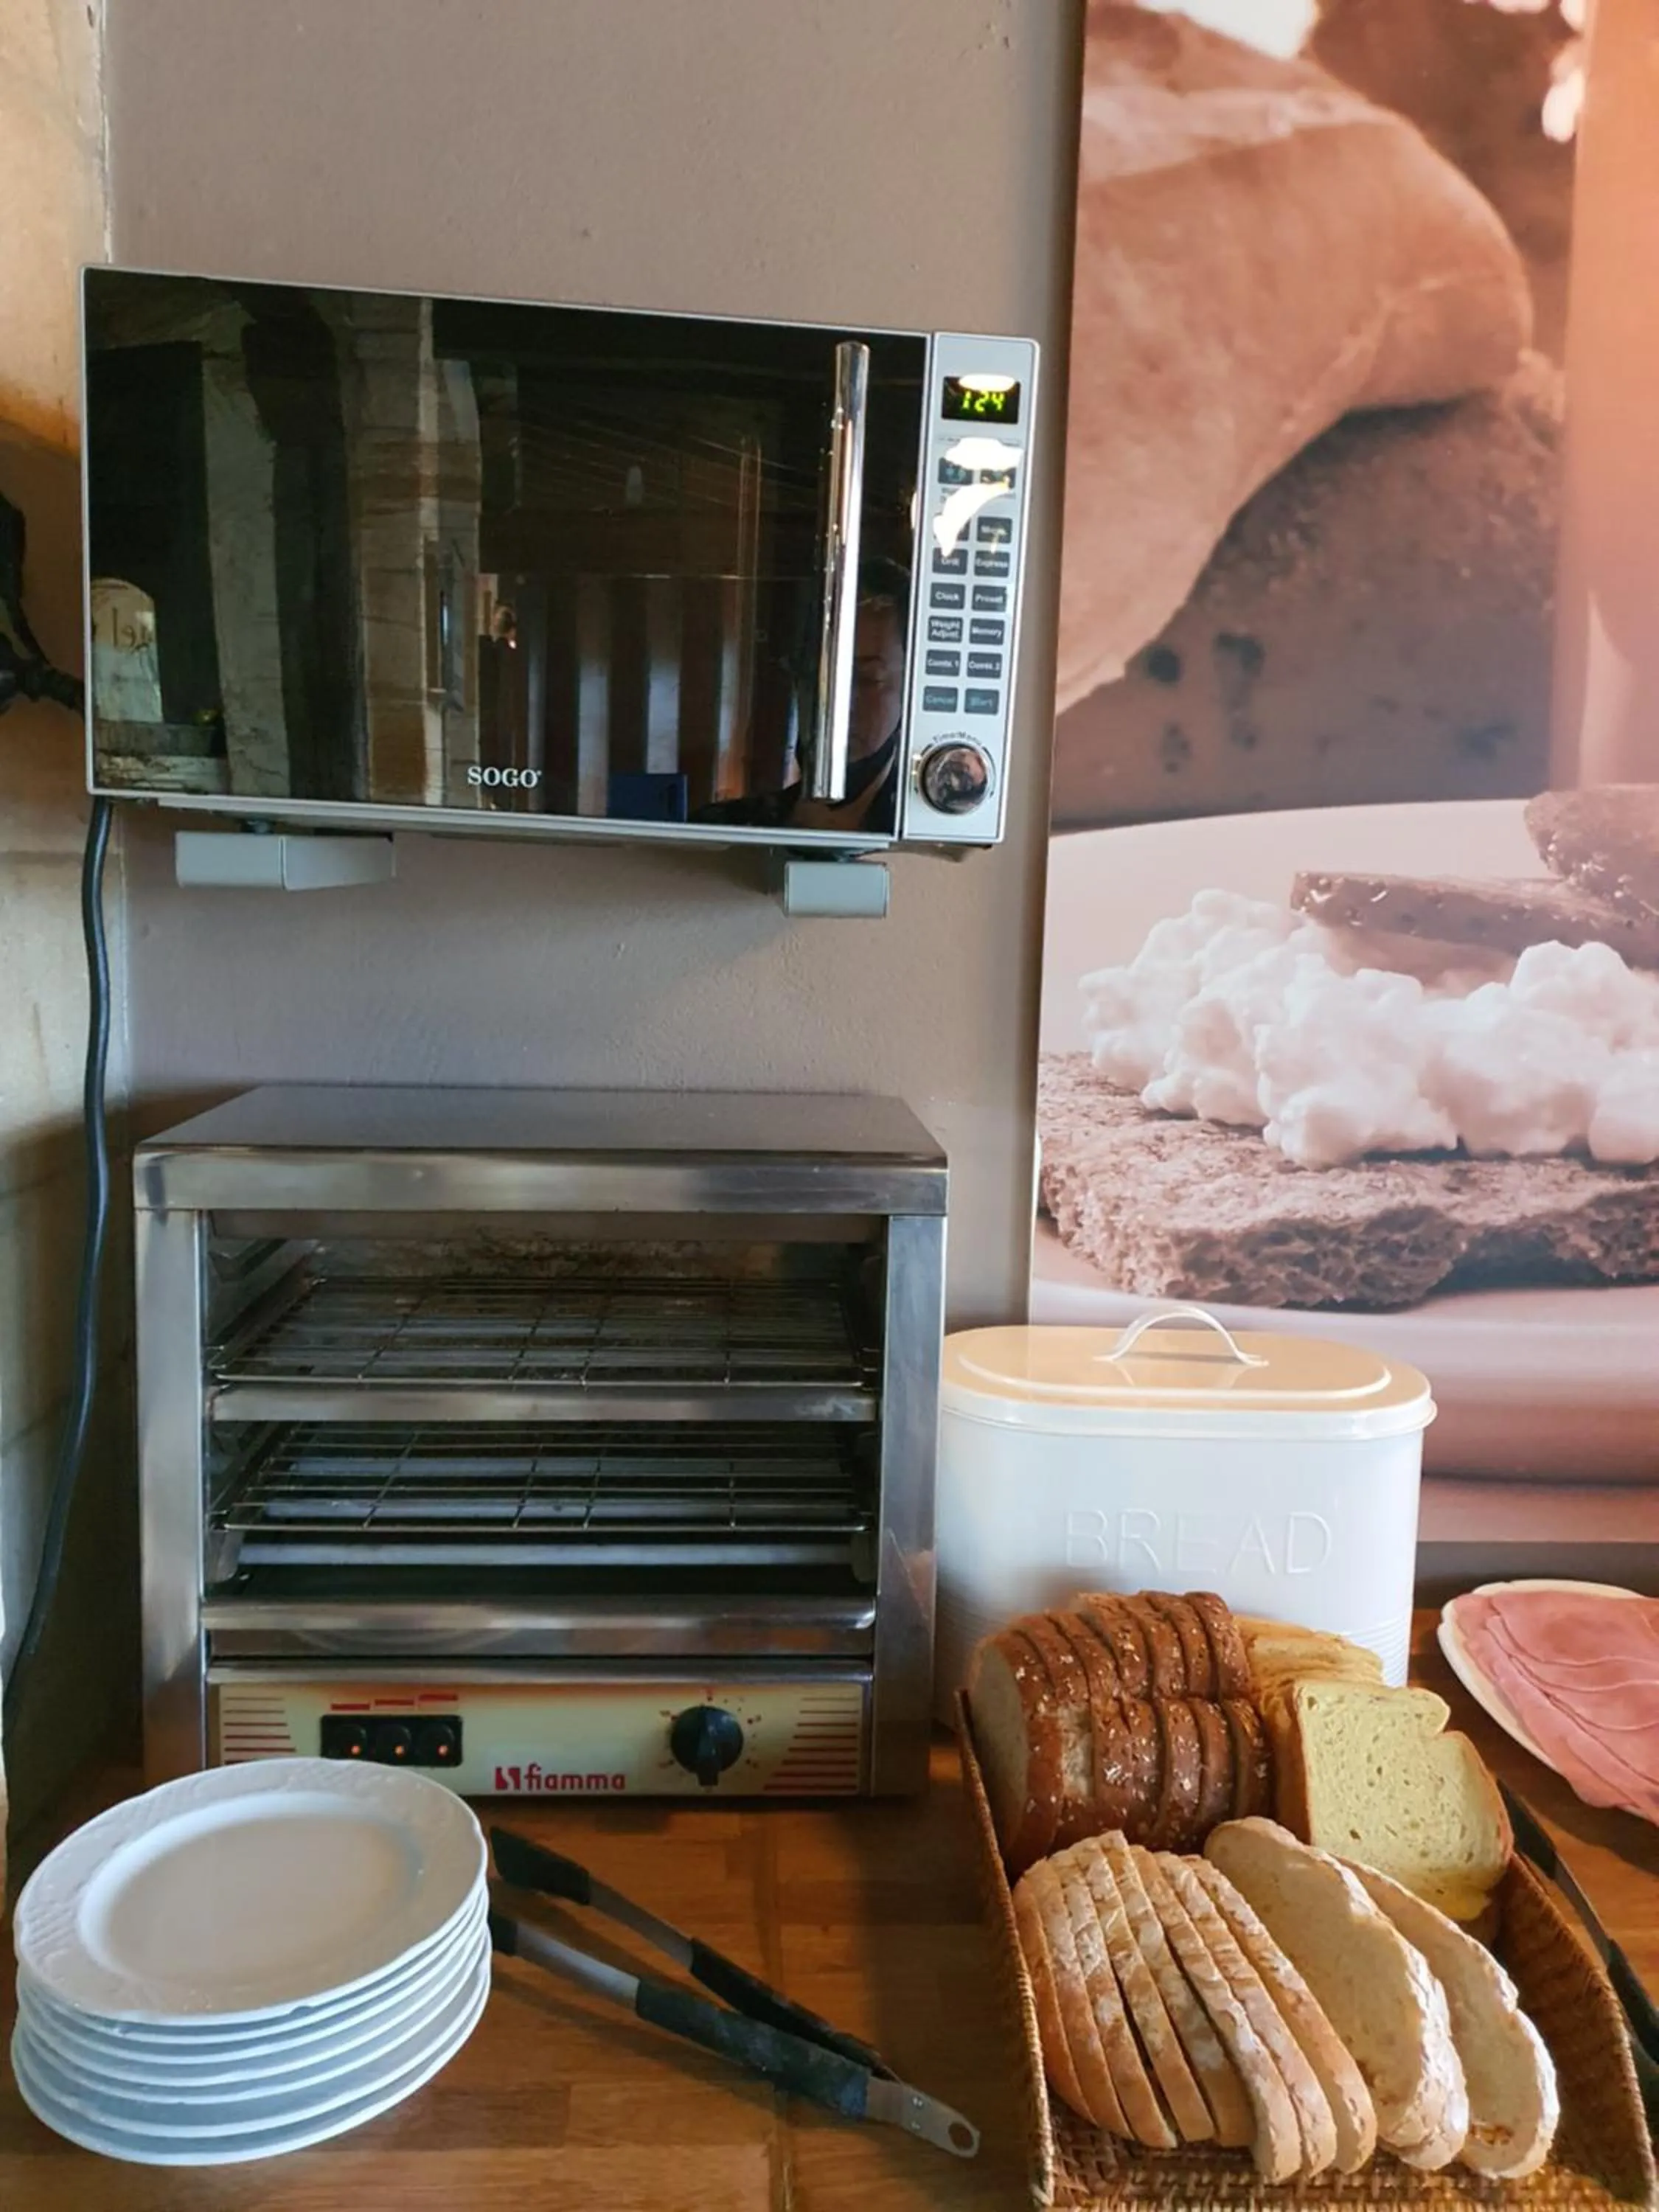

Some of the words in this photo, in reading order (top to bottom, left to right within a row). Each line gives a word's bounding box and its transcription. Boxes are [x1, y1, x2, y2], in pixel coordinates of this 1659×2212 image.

[935, 591, 959, 602] Clock
[975, 594, 1004, 603] Preset
[972, 626, 1001, 638] Memory
[467, 766, 539, 788] SOGO
[1064, 1509, 1332, 1575] BREAD
[524, 1761, 626, 1791] fiamma
